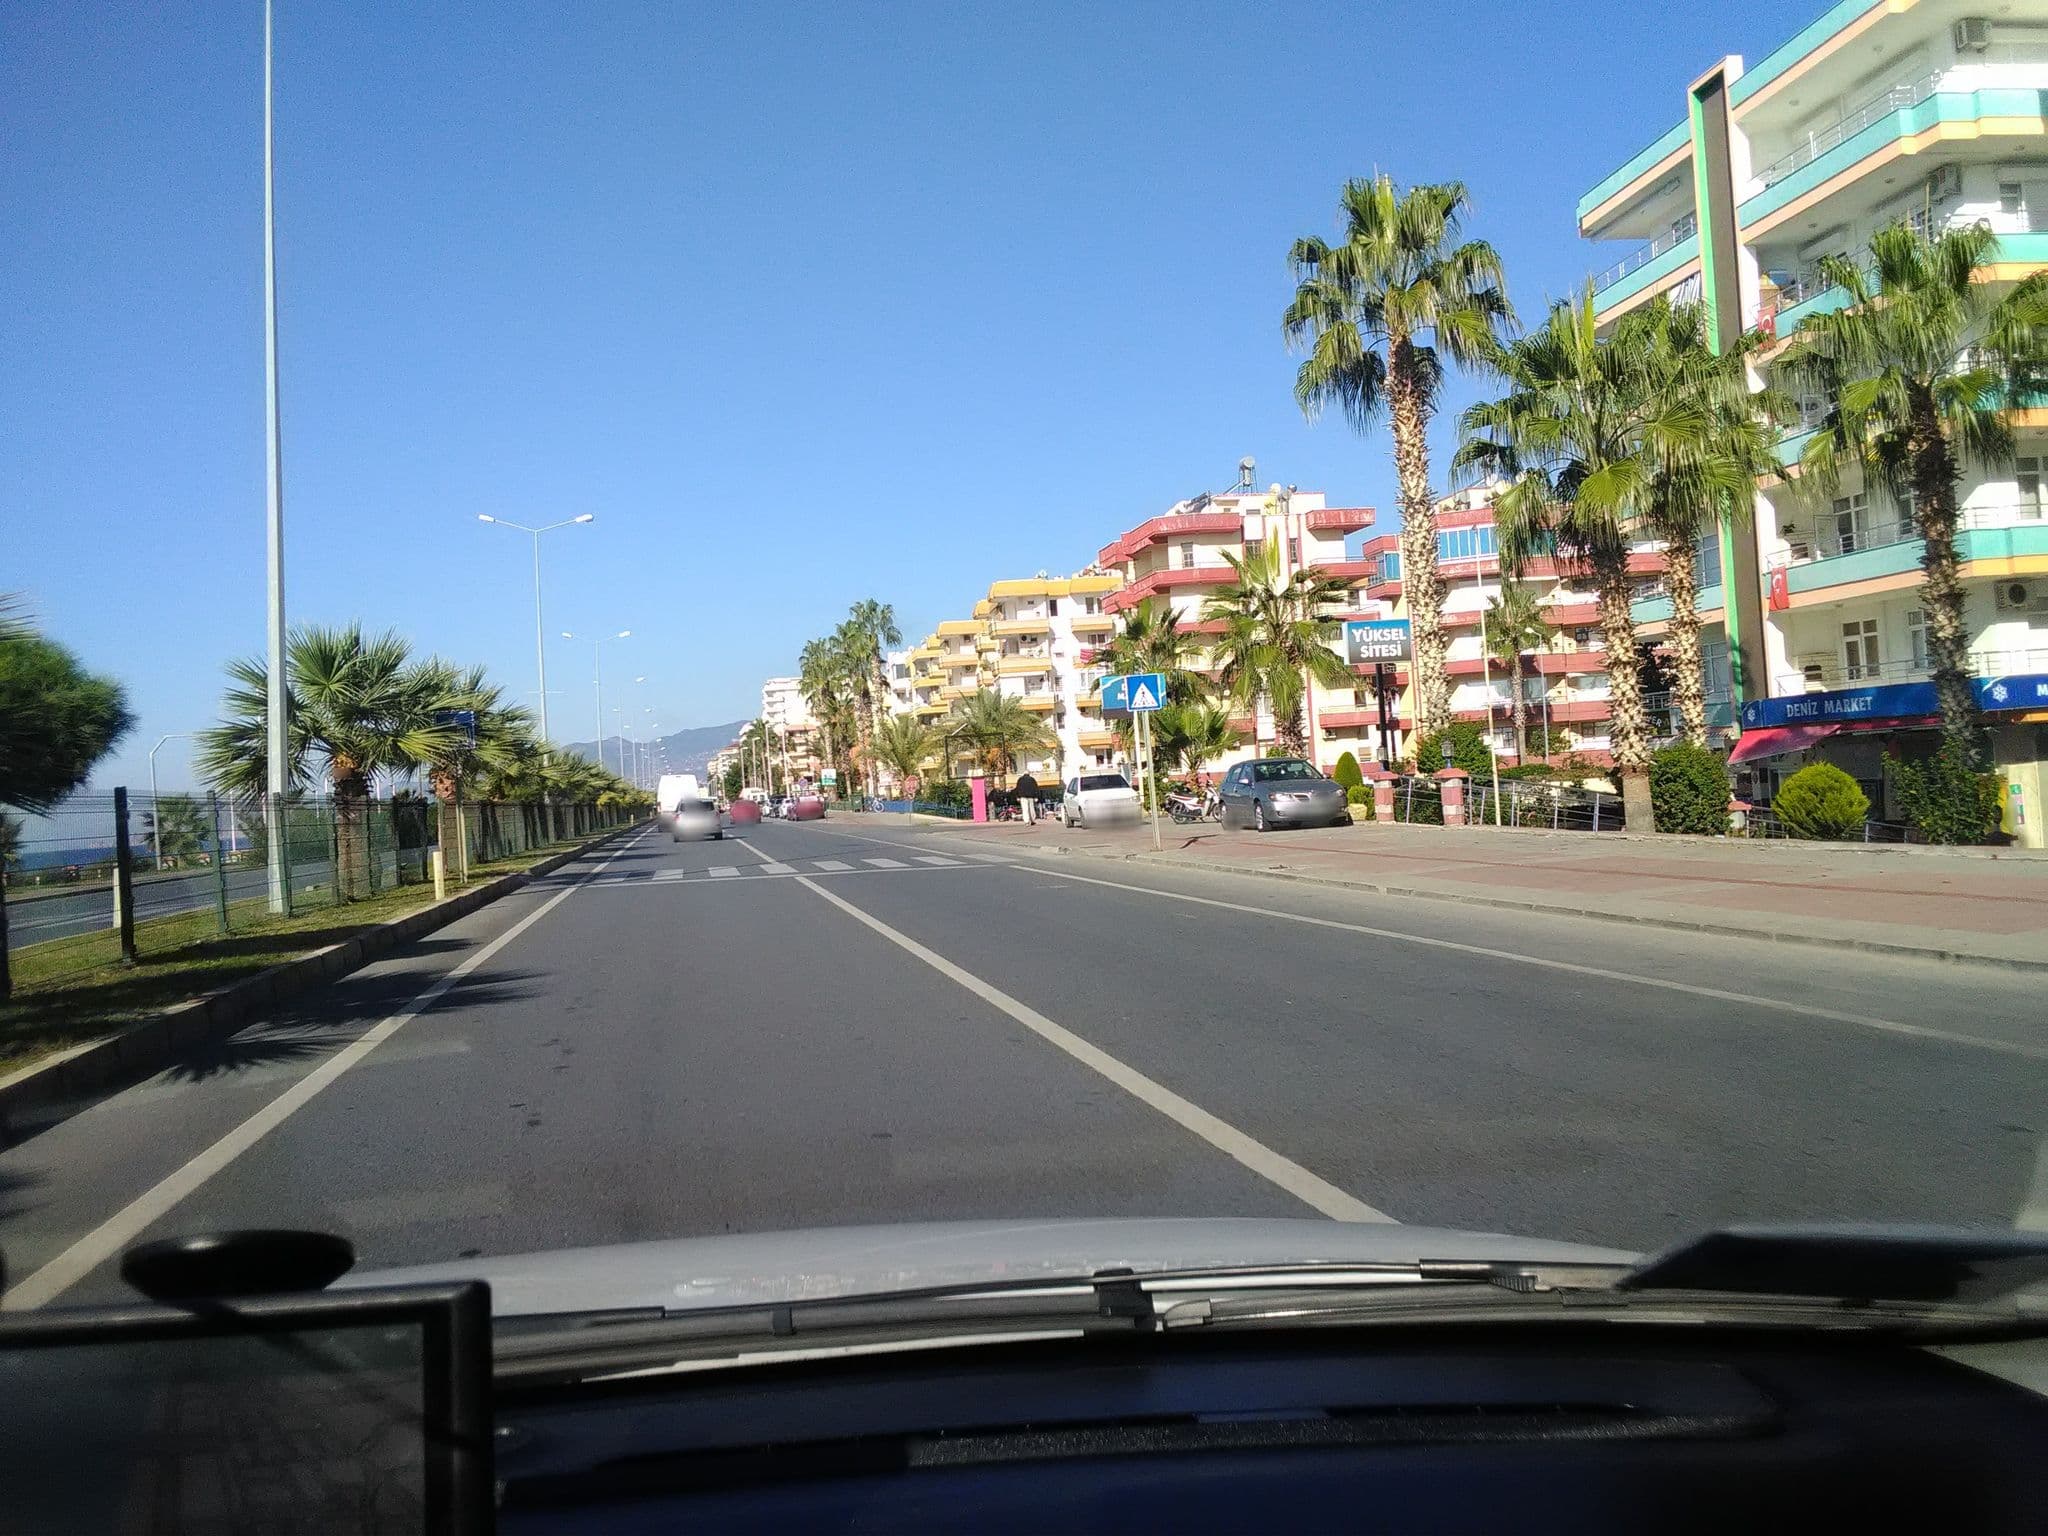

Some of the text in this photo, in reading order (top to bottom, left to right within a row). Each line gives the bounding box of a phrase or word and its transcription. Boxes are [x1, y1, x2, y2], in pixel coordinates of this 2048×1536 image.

[1352, 626, 1407, 642] YÜKSEL
[1360, 641, 1402, 658] SİTESİ
[1786, 697, 1873, 717] DENİZ MARKET
